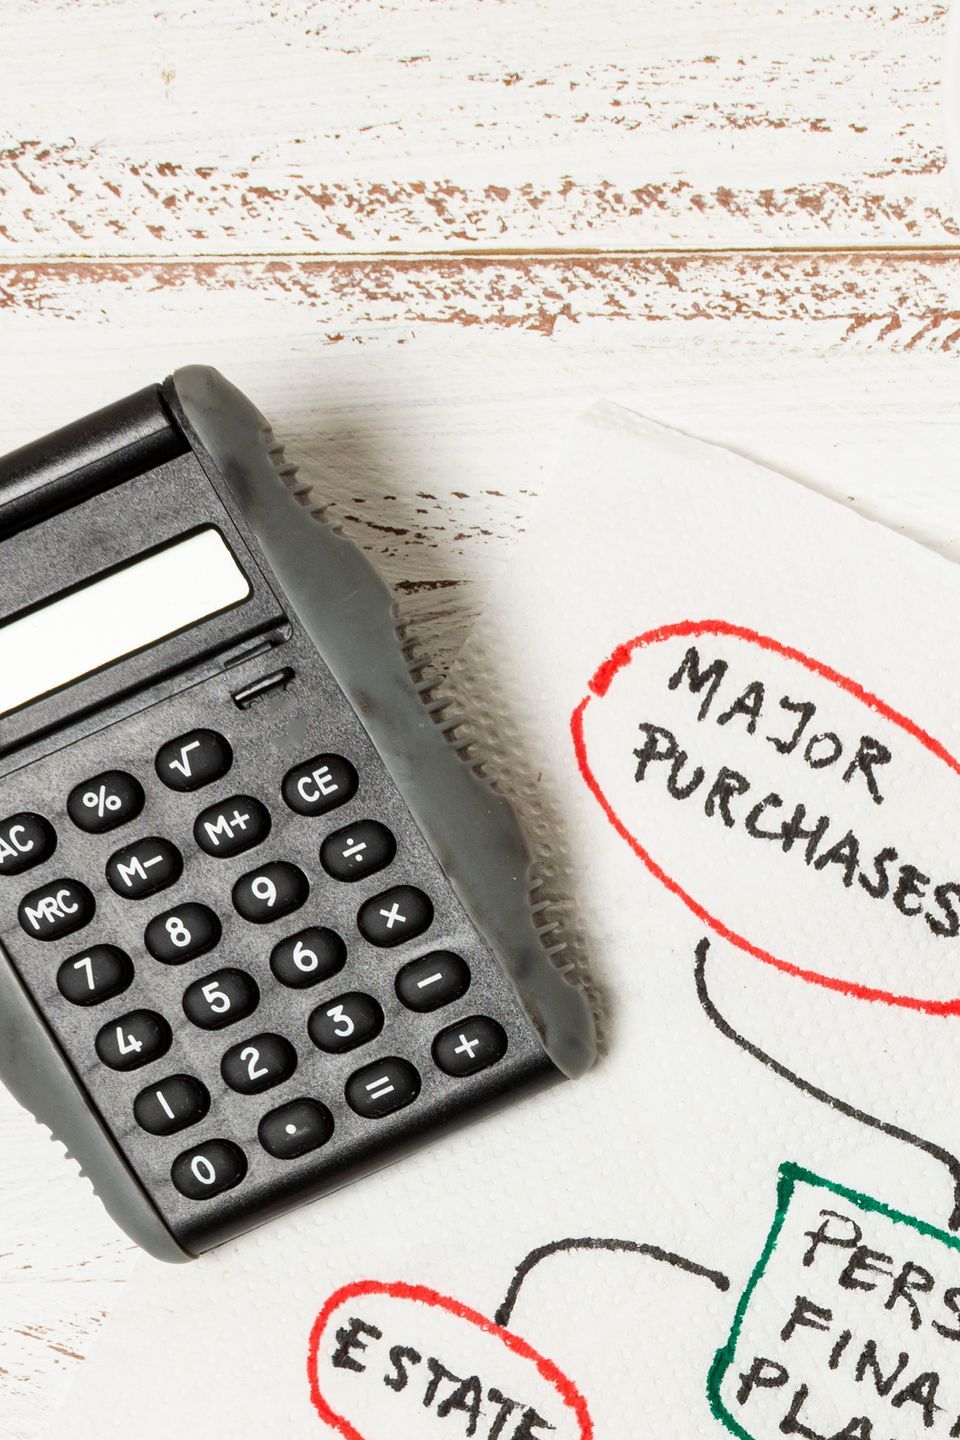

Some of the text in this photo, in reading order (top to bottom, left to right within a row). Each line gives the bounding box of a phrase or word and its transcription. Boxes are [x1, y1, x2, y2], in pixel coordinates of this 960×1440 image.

[668, 646, 892, 805] MAJOR
[298, 766, 338, 802] CE
[83, 785, 121, 817] %
[204, 811, 249, 845] M+
[0, 825, 34, 863] AC
[117, 856, 163, 886] M-
[251, 877, 276, 906] 9
[25, 889, 79, 931] MRC
[165, 917, 191, 947] 8
[293, 941, 318, 971] 6
[74, 957, 95, 989] 7
[202, 982, 230, 1013] 5
[327, 1005, 354, 1036] 3
[116, 1027, 142, 1054] 4
[240, 1047, 268, 1080] 2
[191, 1156, 215, 1184] 0
